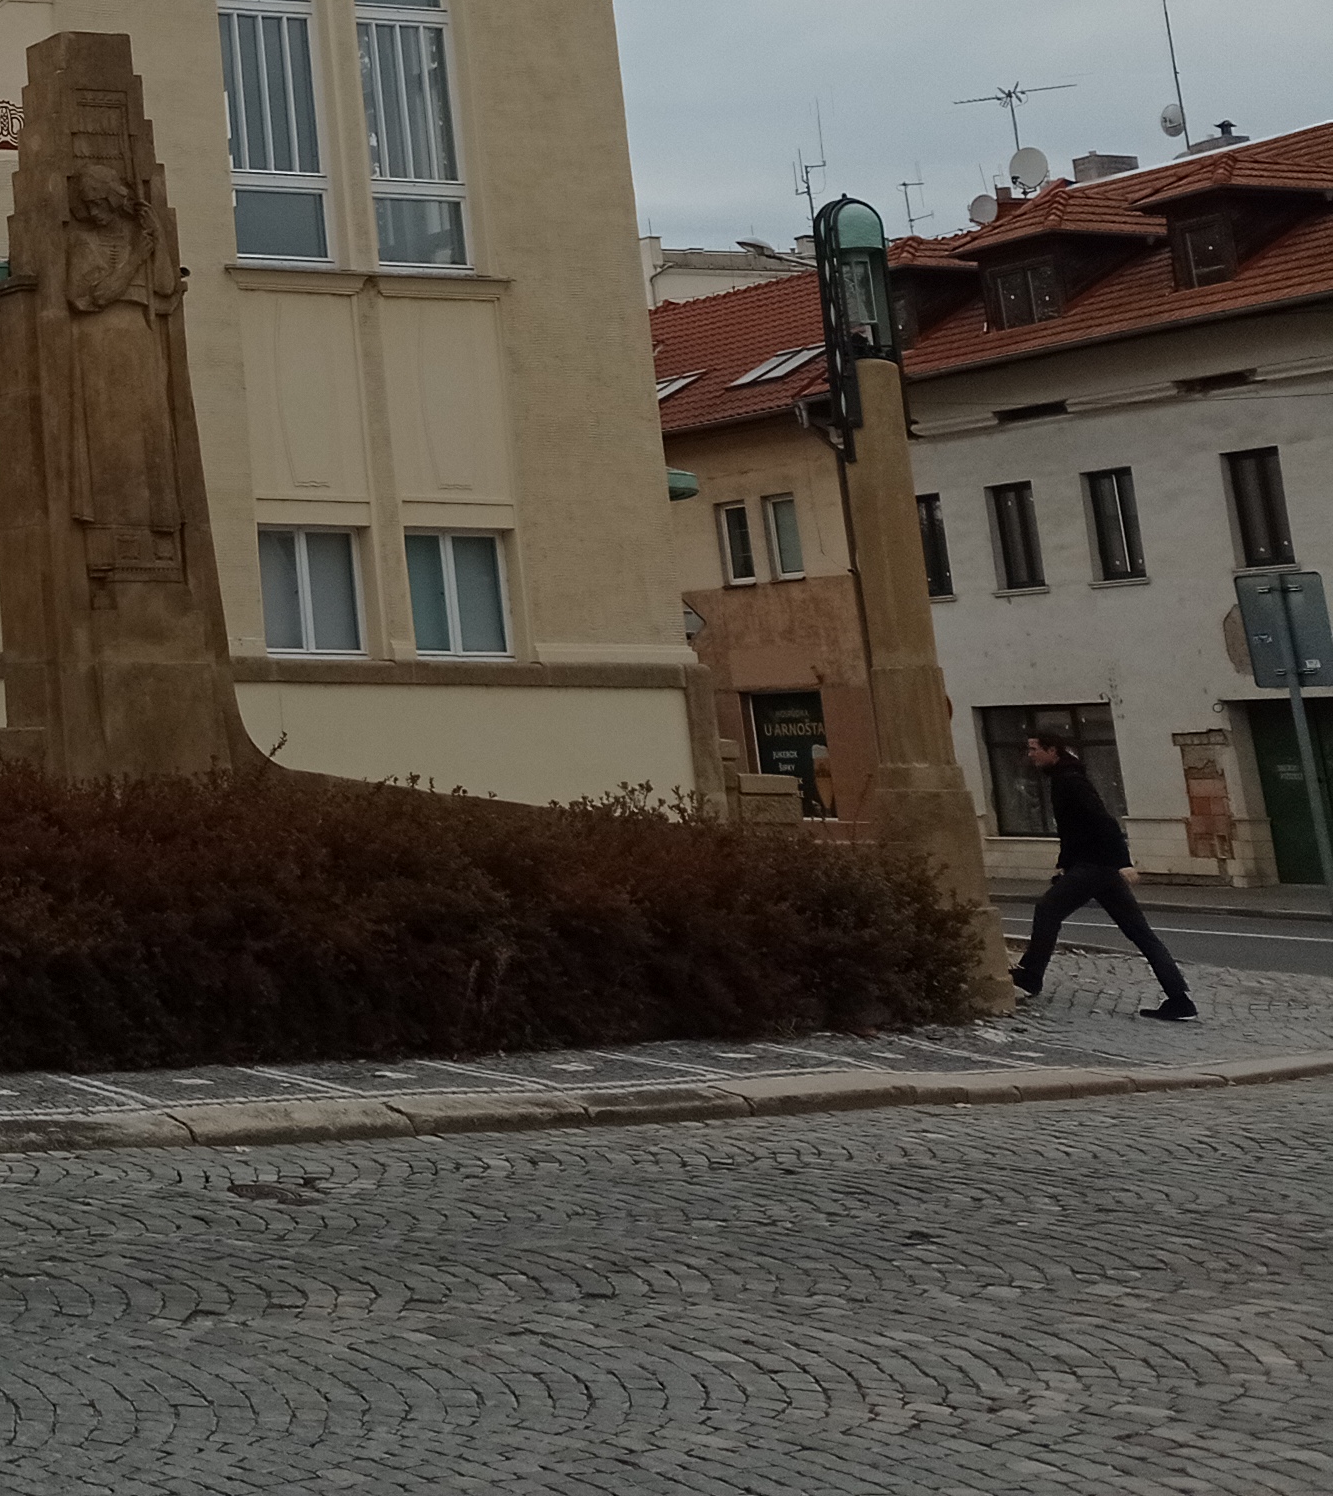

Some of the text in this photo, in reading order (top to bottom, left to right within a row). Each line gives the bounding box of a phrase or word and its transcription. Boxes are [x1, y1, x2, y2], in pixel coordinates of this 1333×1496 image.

[764, 718, 826, 736] U ARNOŠTA
[773, 750, 798, 759] JUKEBOX
